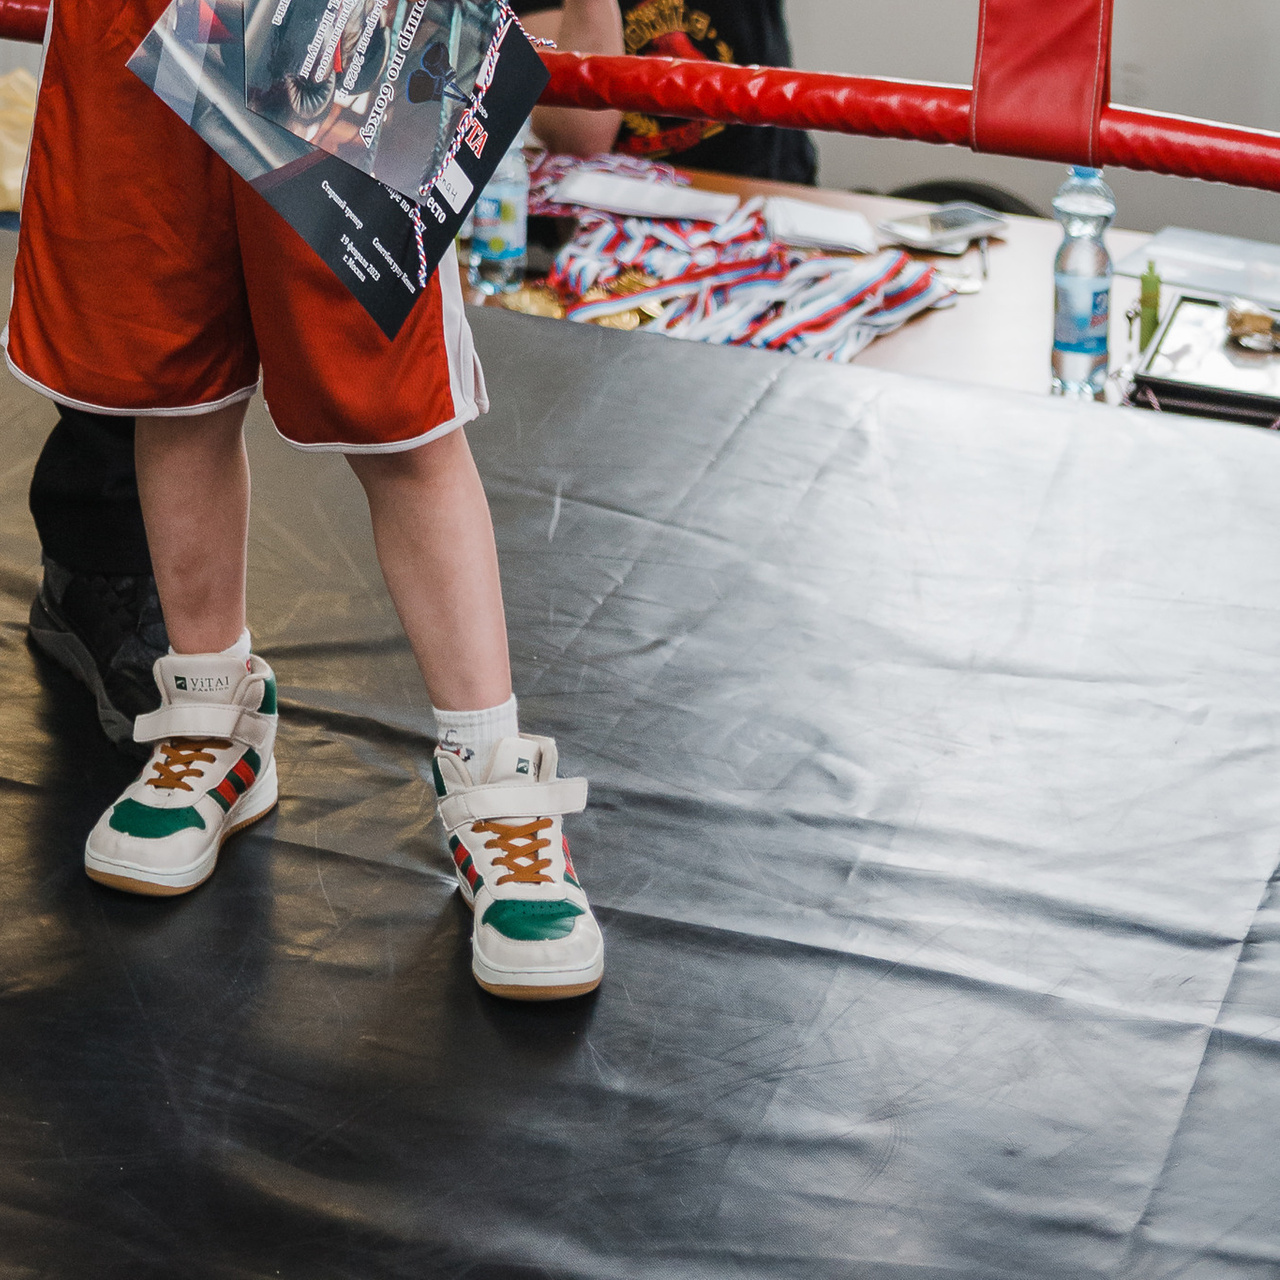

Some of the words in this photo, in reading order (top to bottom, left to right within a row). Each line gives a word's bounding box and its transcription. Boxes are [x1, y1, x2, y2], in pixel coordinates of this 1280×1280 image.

[386, 53, 408, 82] по
[358, 82, 396, 149] боксу
[426, 195, 447, 224] есто
